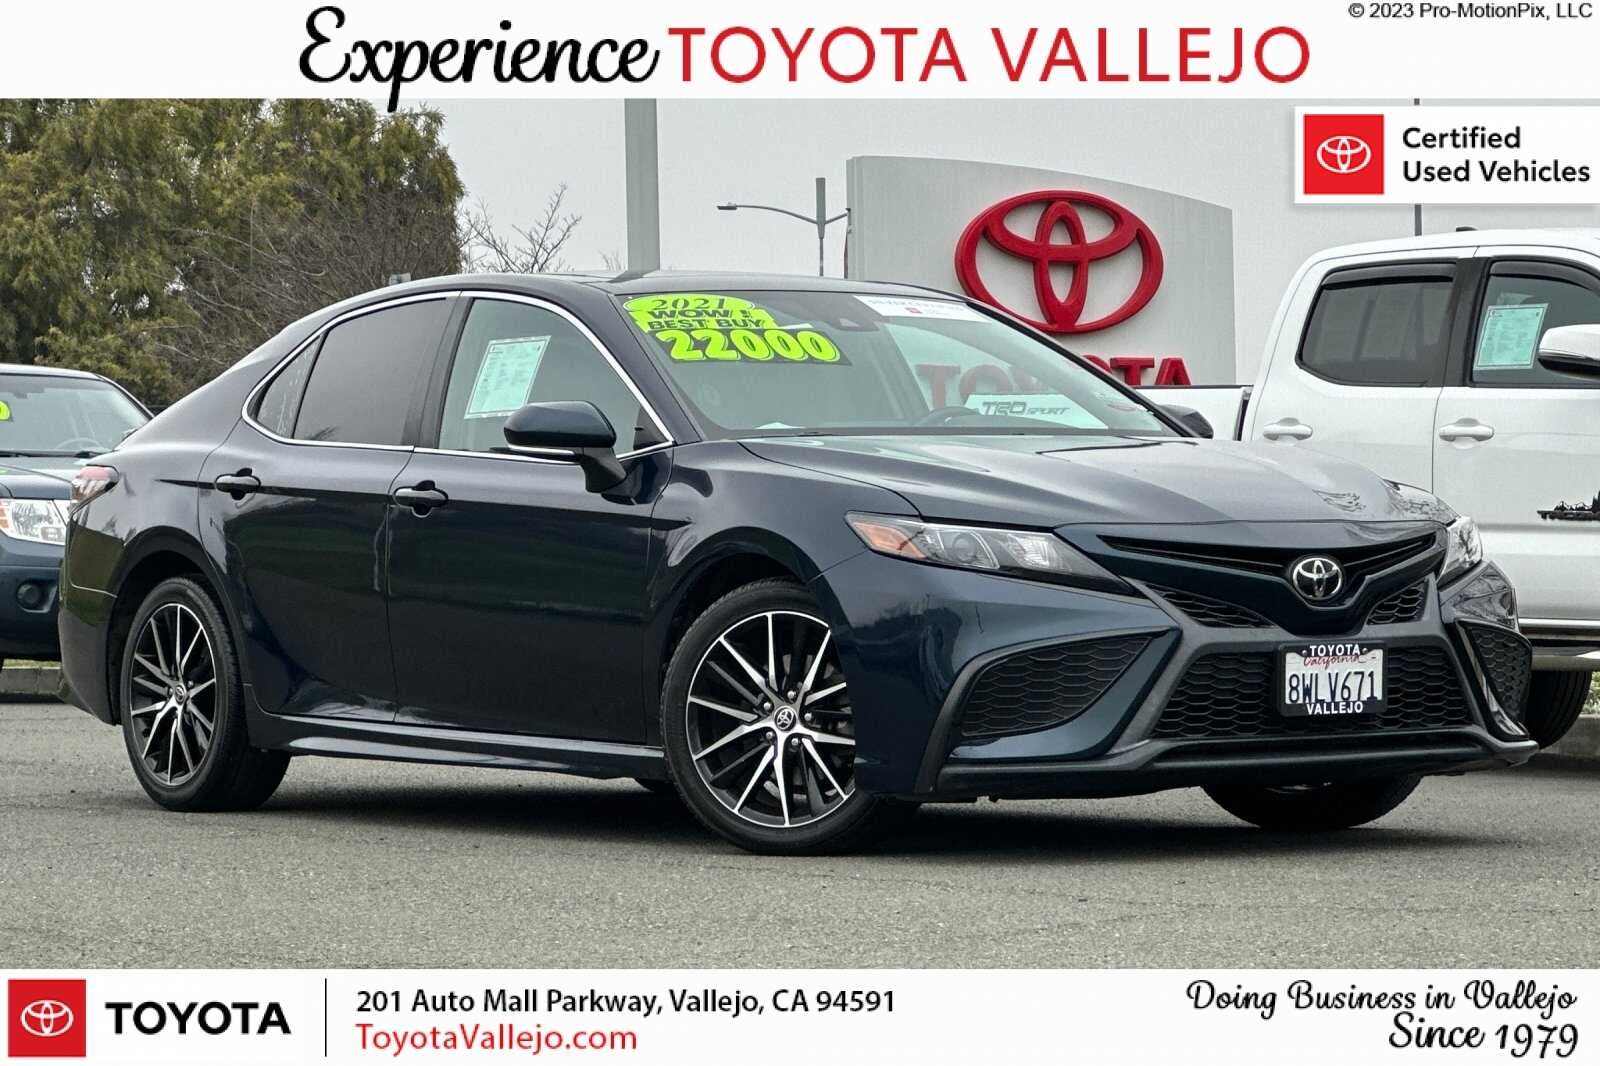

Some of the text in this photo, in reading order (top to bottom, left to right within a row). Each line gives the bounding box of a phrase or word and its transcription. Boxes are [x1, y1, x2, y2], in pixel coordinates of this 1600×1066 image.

[651, 298, 726, 310] 2021
[648, 319, 763, 329] BEST BUY
[656, 329, 841, 361] 22000
[1309, 644, 1360, 657] TOYOTA
[1288, 671, 1378, 704] 8WLV671
[1306, 701, 1364, 715] VALLEJO
